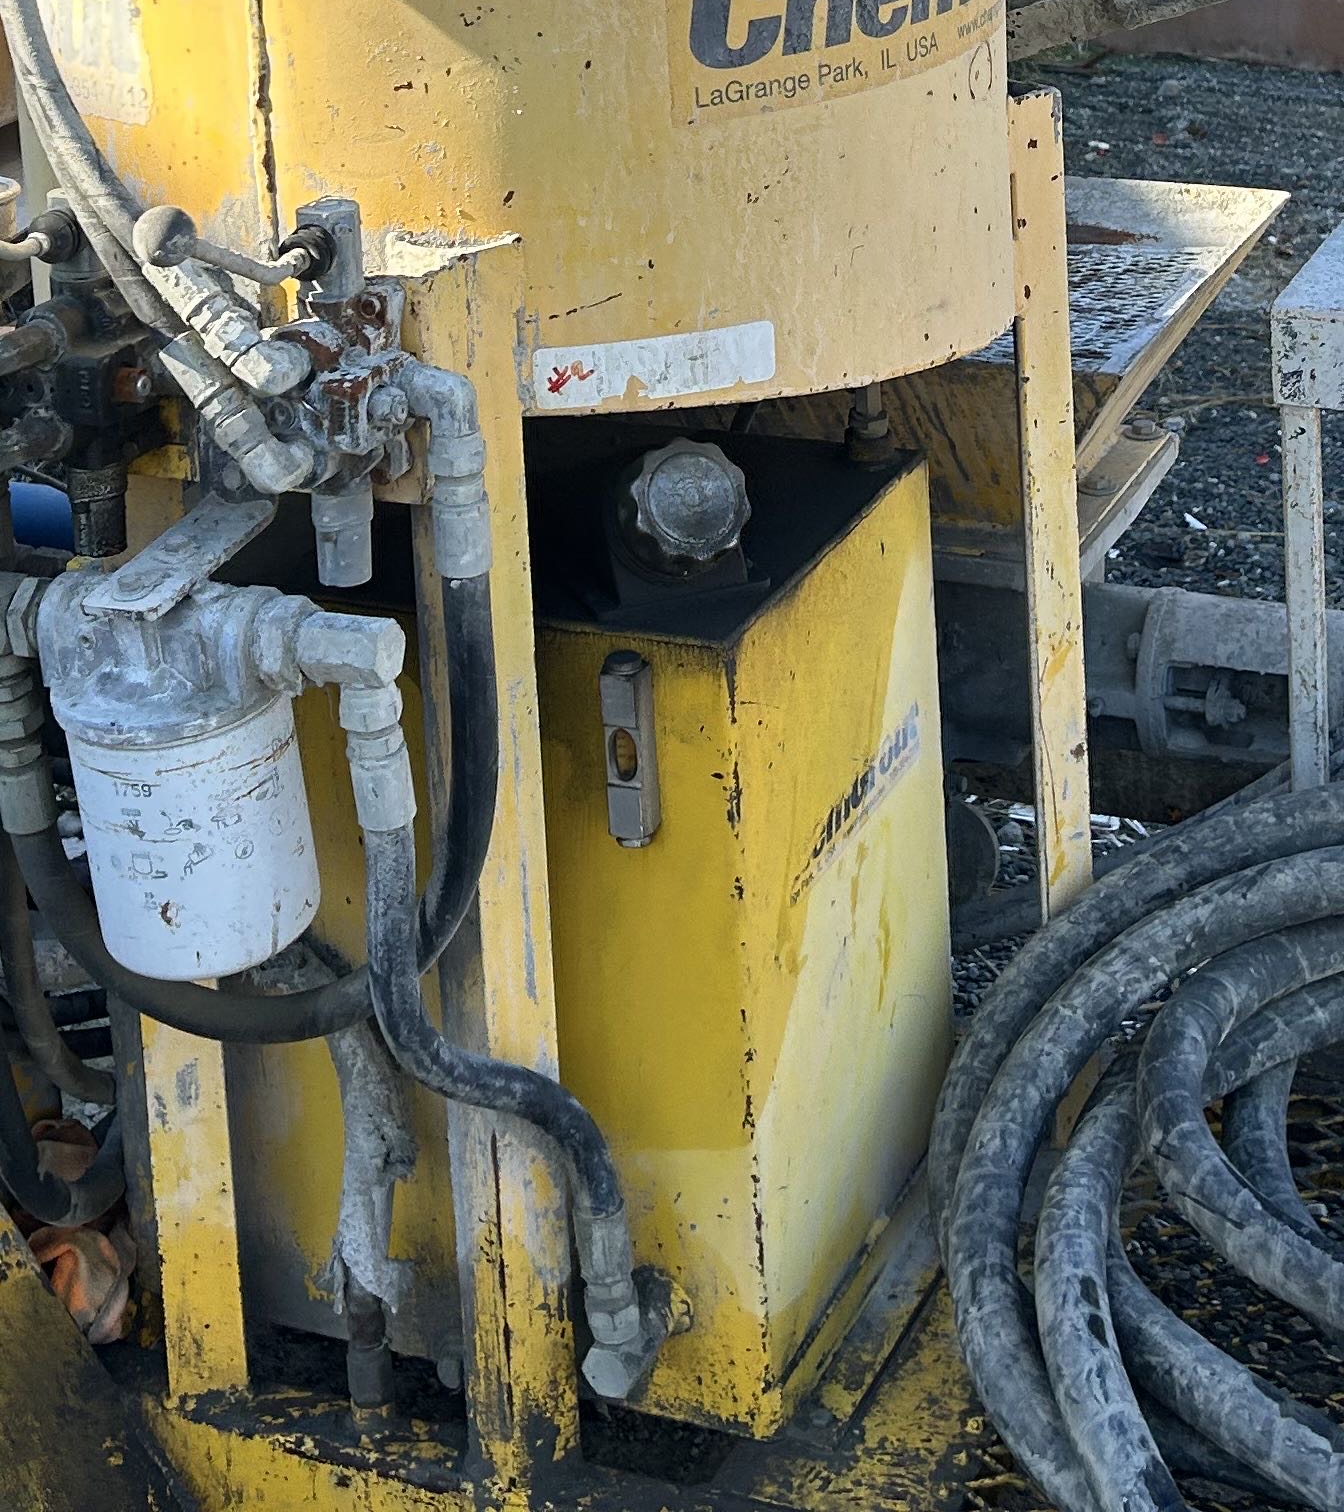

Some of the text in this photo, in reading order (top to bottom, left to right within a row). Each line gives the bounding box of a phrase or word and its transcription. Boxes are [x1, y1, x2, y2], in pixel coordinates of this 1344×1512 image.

[695, 32, 939, 109] LaGrange Park, IL USA
